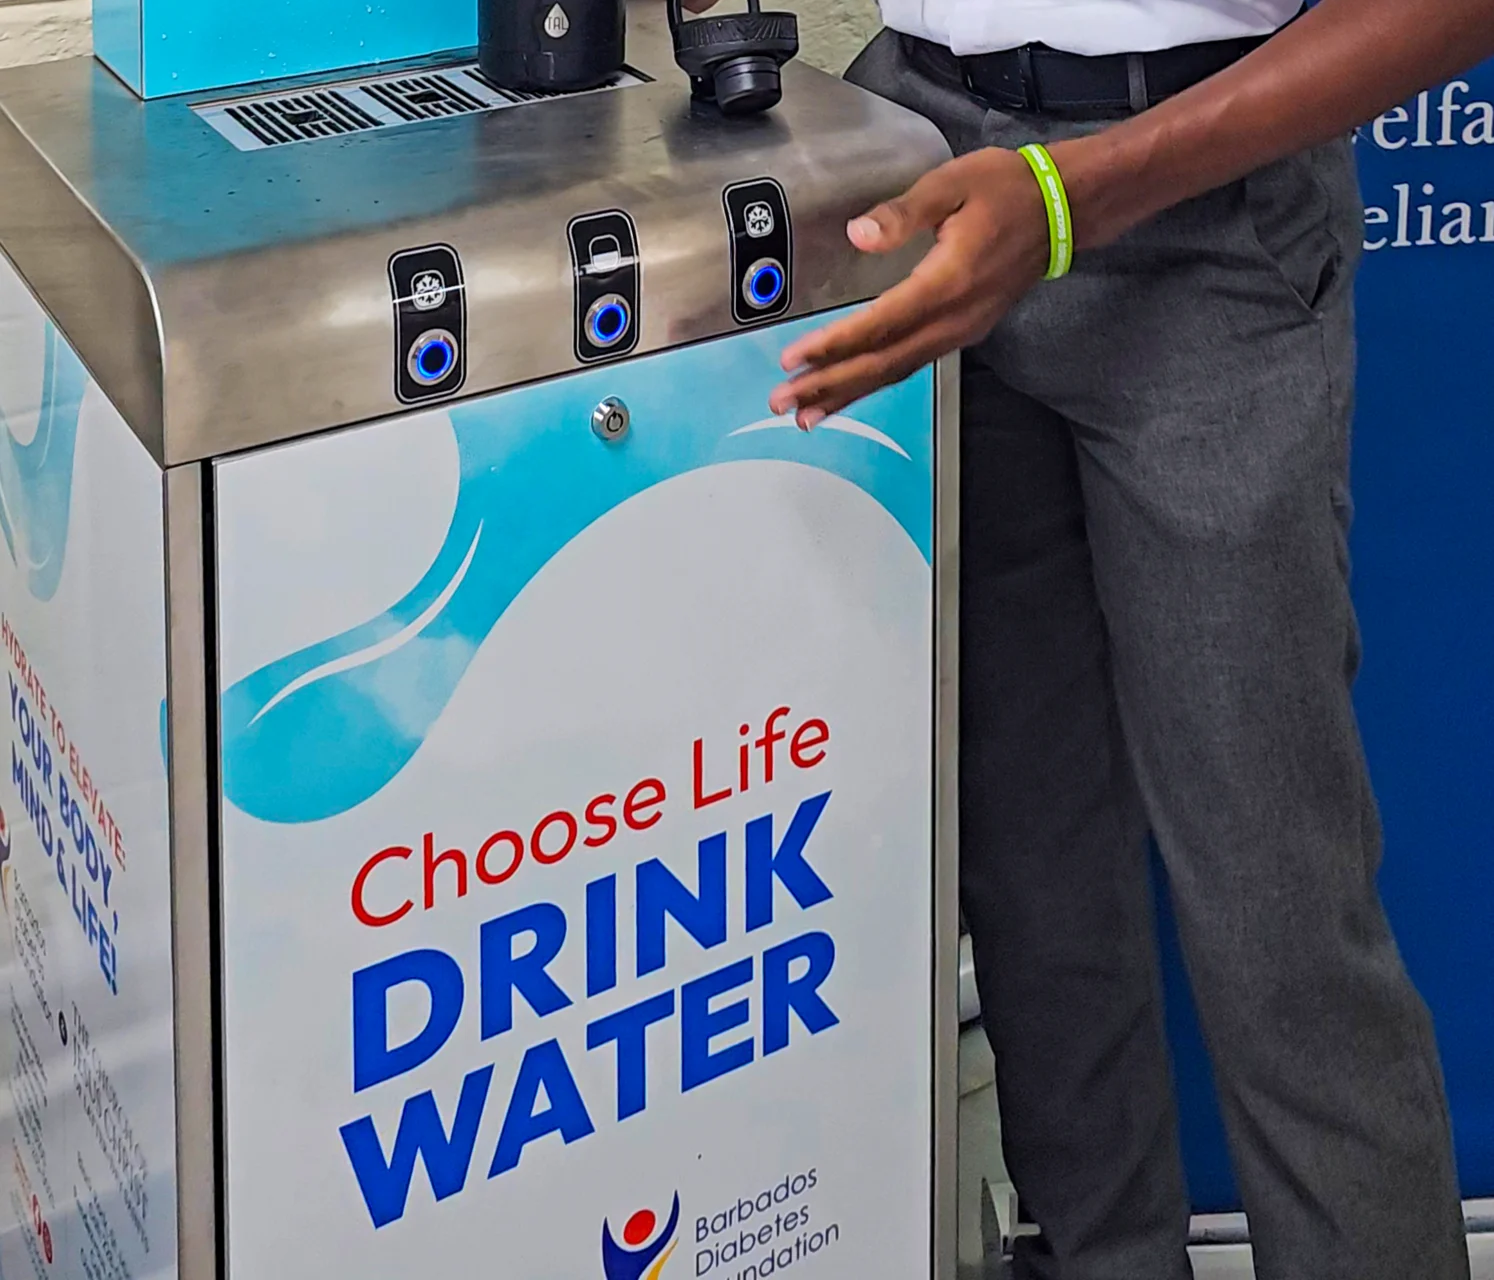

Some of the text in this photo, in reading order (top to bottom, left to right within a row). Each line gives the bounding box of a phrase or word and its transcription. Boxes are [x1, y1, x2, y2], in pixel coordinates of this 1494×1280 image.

[547, 16, 569, 31] TAL
[1372, 80, 1494, 150] elfa
[1362, 183, 1494, 251] elia
[2, 611, 47, 721] HYDRATE
[50, 704, 66, 755] TO
[8, 670, 54, 799] YOUR
[350, 706, 830, 927] Choose Life
[12, 740, 54, 858] MIND
[56, 837, 68, 895] &
[72, 863, 118, 996] LIFE!
[352, 789, 834, 1094] DRINK
[338, 930, 840, 1230] WATER
[695, 1167, 818, 1243] Barbados
[695, 1205, 809, 1277] Diabetes
[725, 1223, 840, 1280] ndation
